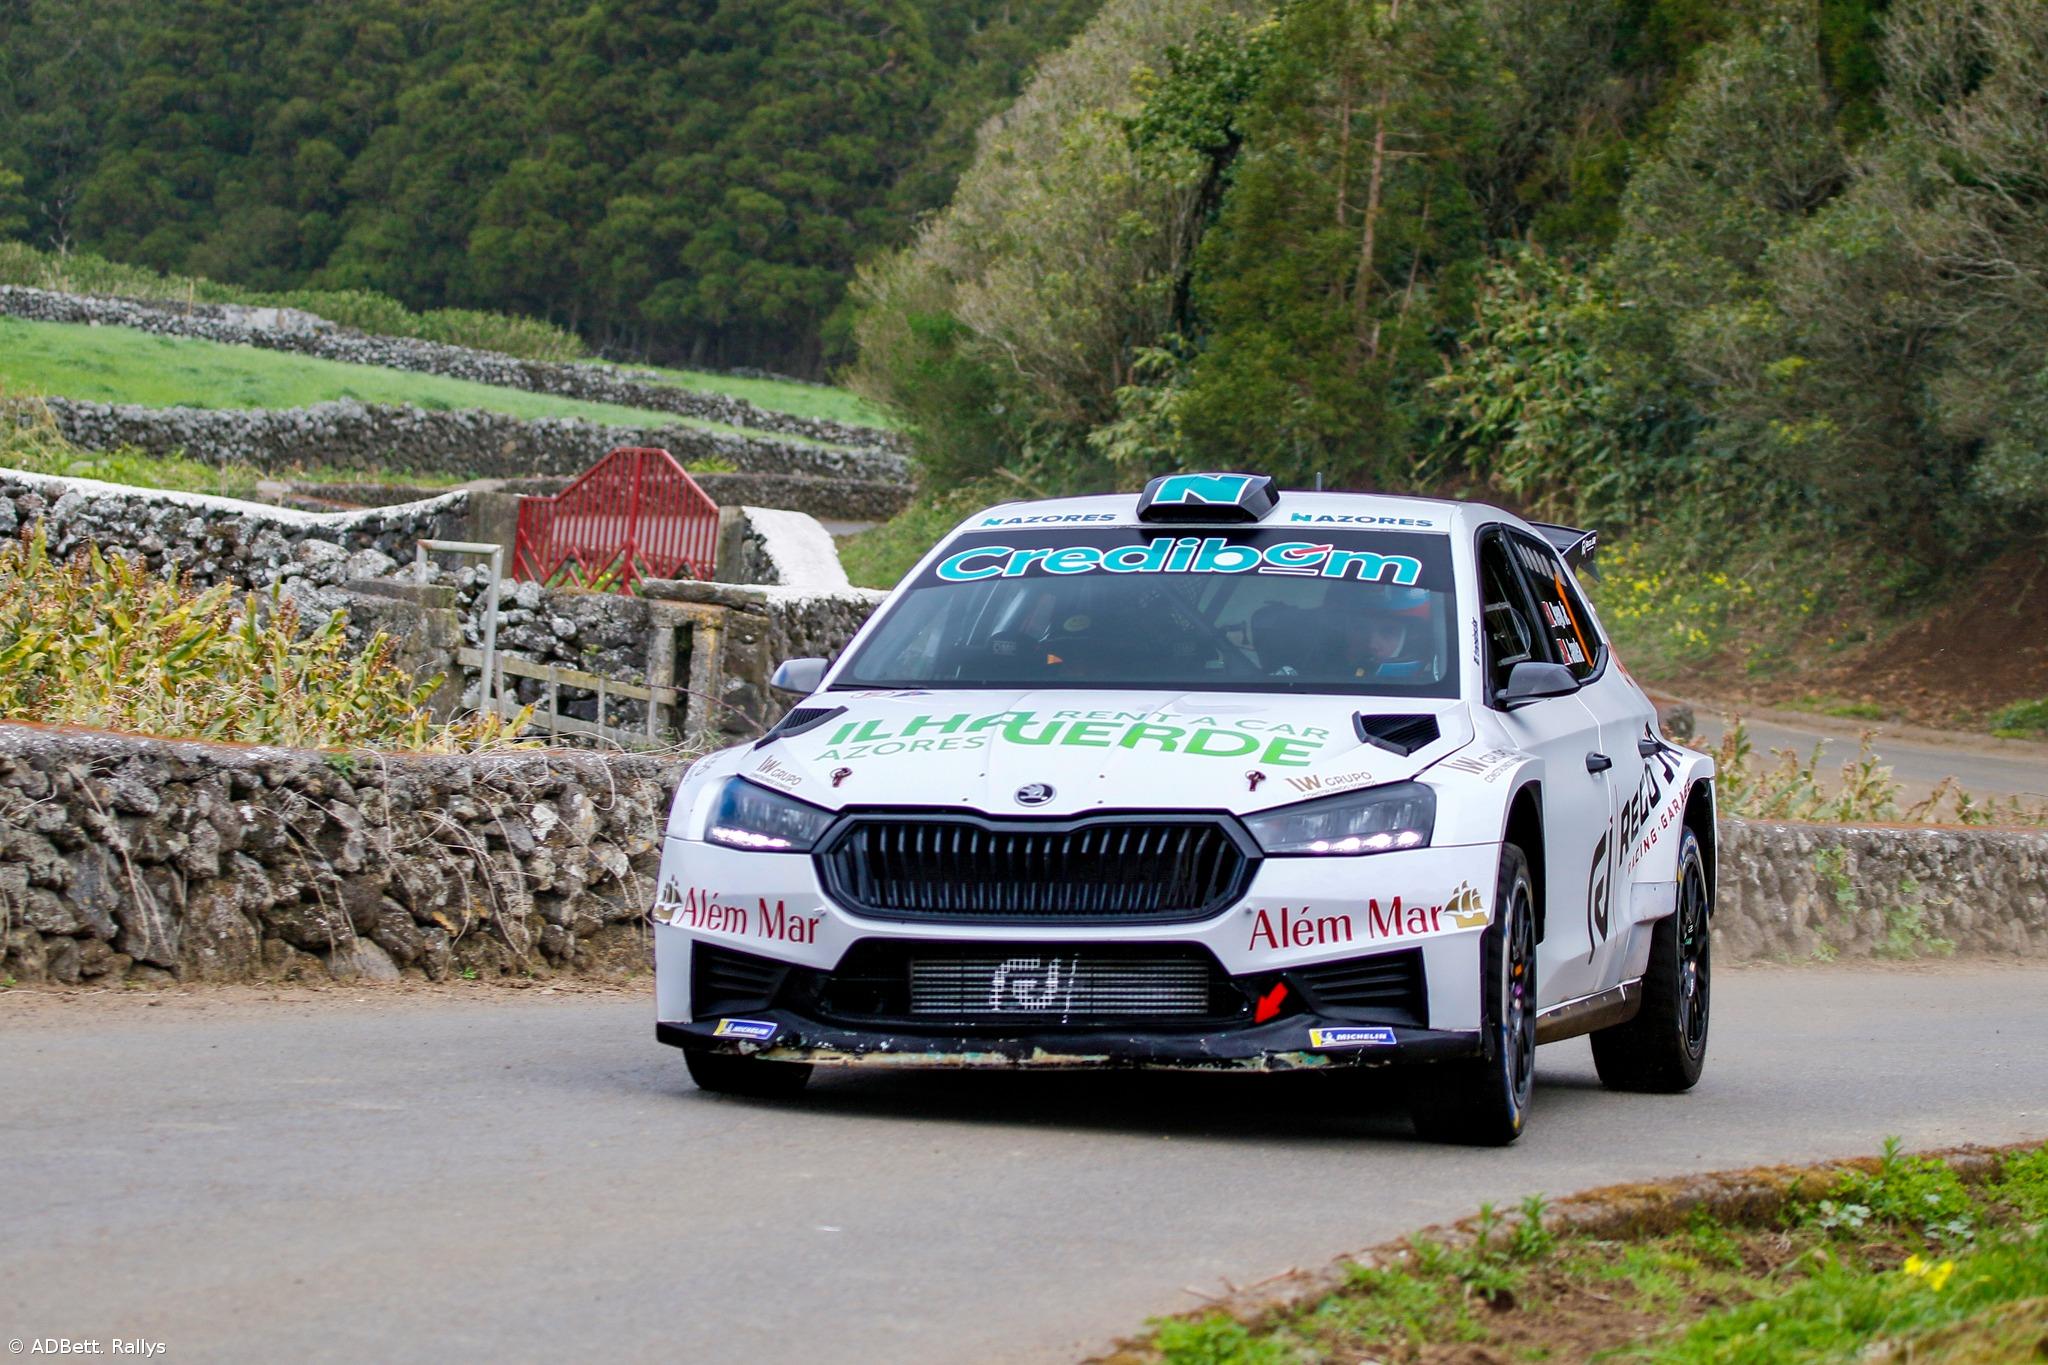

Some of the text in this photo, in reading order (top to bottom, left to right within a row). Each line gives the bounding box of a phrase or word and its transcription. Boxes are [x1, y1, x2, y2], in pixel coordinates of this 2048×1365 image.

[1151, 474, 1252, 505] N
[935, 537, 1422, 585] Credibom
[1052, 710, 1330, 740] RENT A CAR
[813, 736, 987, 761] AZORES
[770, 768, 802, 786] GRUPO
[1324, 771, 1373, 786] GRUPO
[680, 886, 820, 945] Além Mar
[1249, 895, 1442, 952] Além Mar
[1336, 1032, 1387, 1041] MICHELIN
